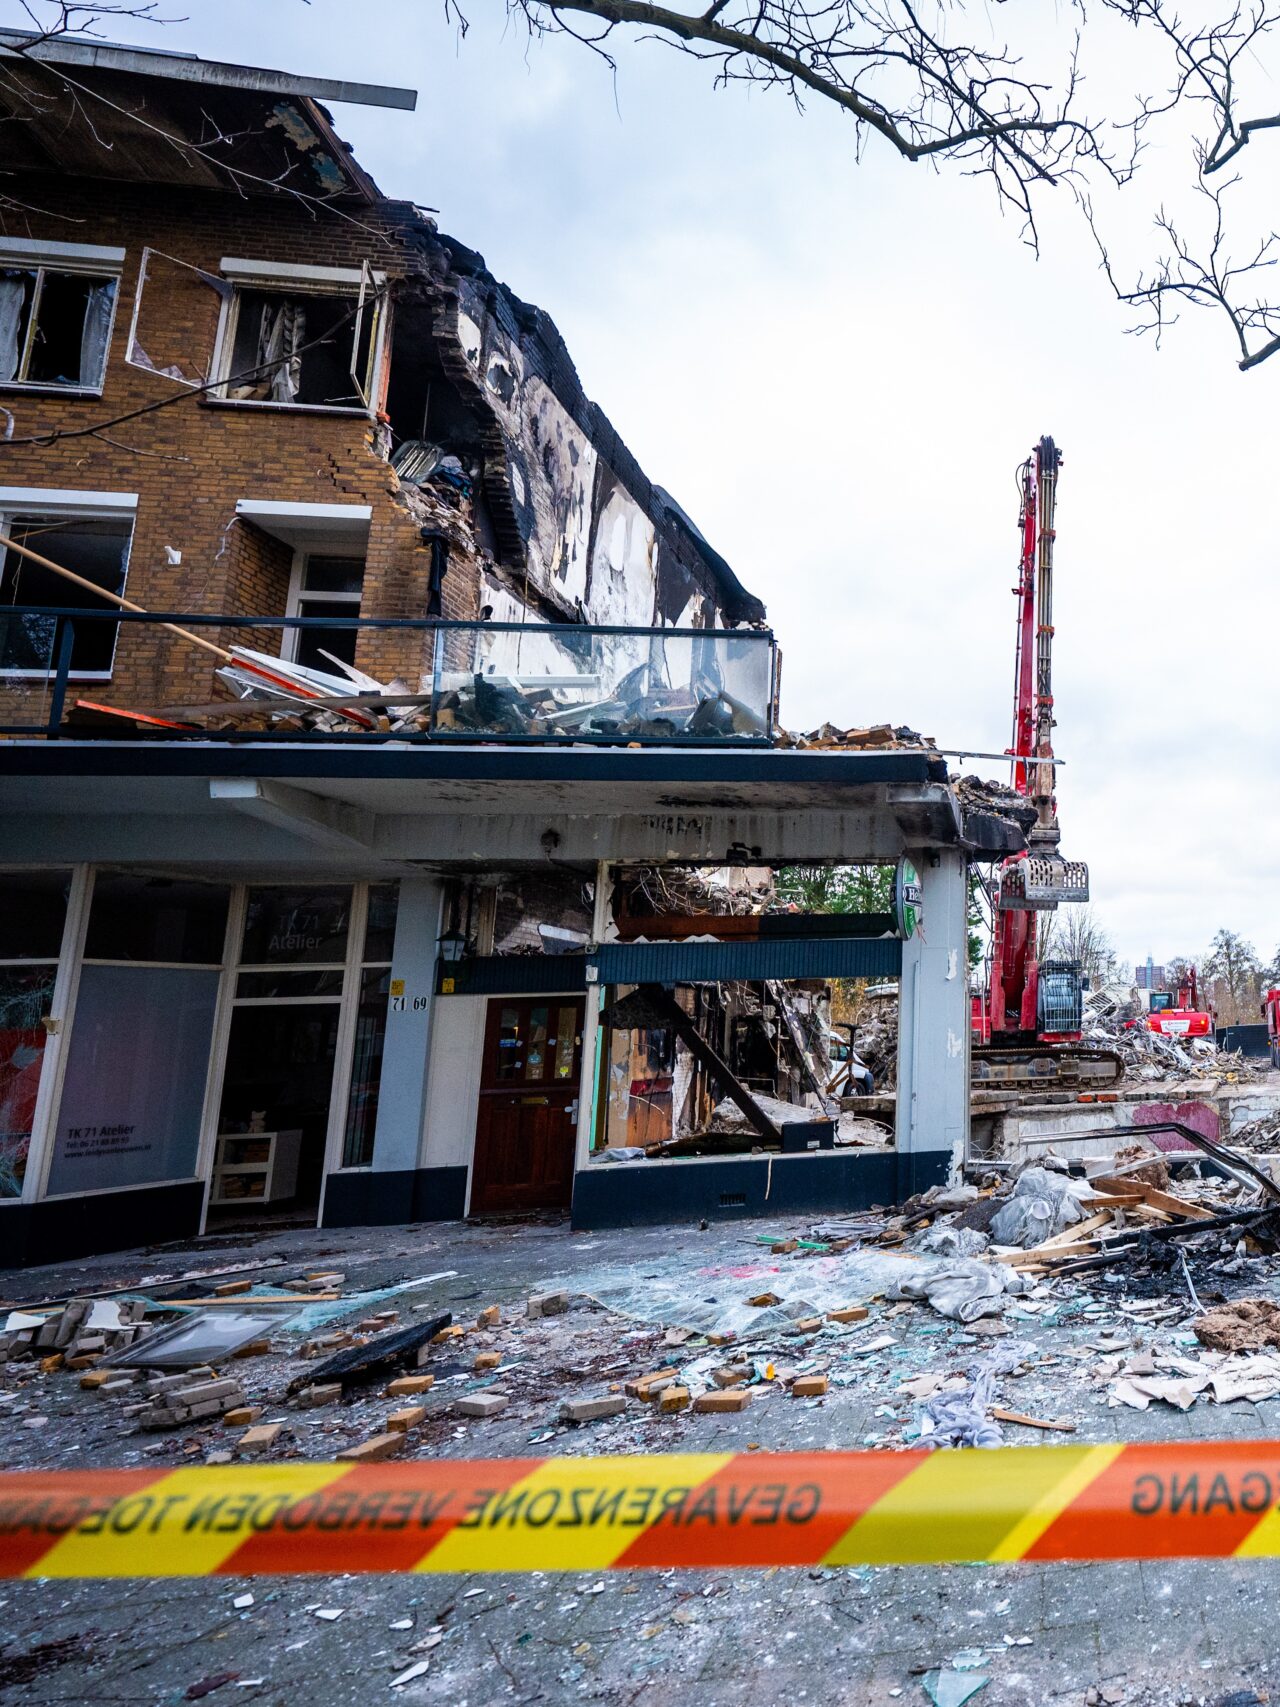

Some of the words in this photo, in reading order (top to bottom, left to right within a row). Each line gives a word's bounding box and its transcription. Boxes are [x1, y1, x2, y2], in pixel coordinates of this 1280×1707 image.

[268, 934, 323, 951] Atelier
[393, 997, 406, 1011] 71
[413, 997, 427, 1010] 69
[68, 1128, 81, 1139] TK
[84, 1126, 97, 1138] 71
[100, 1124, 136, 1136] Atelier
